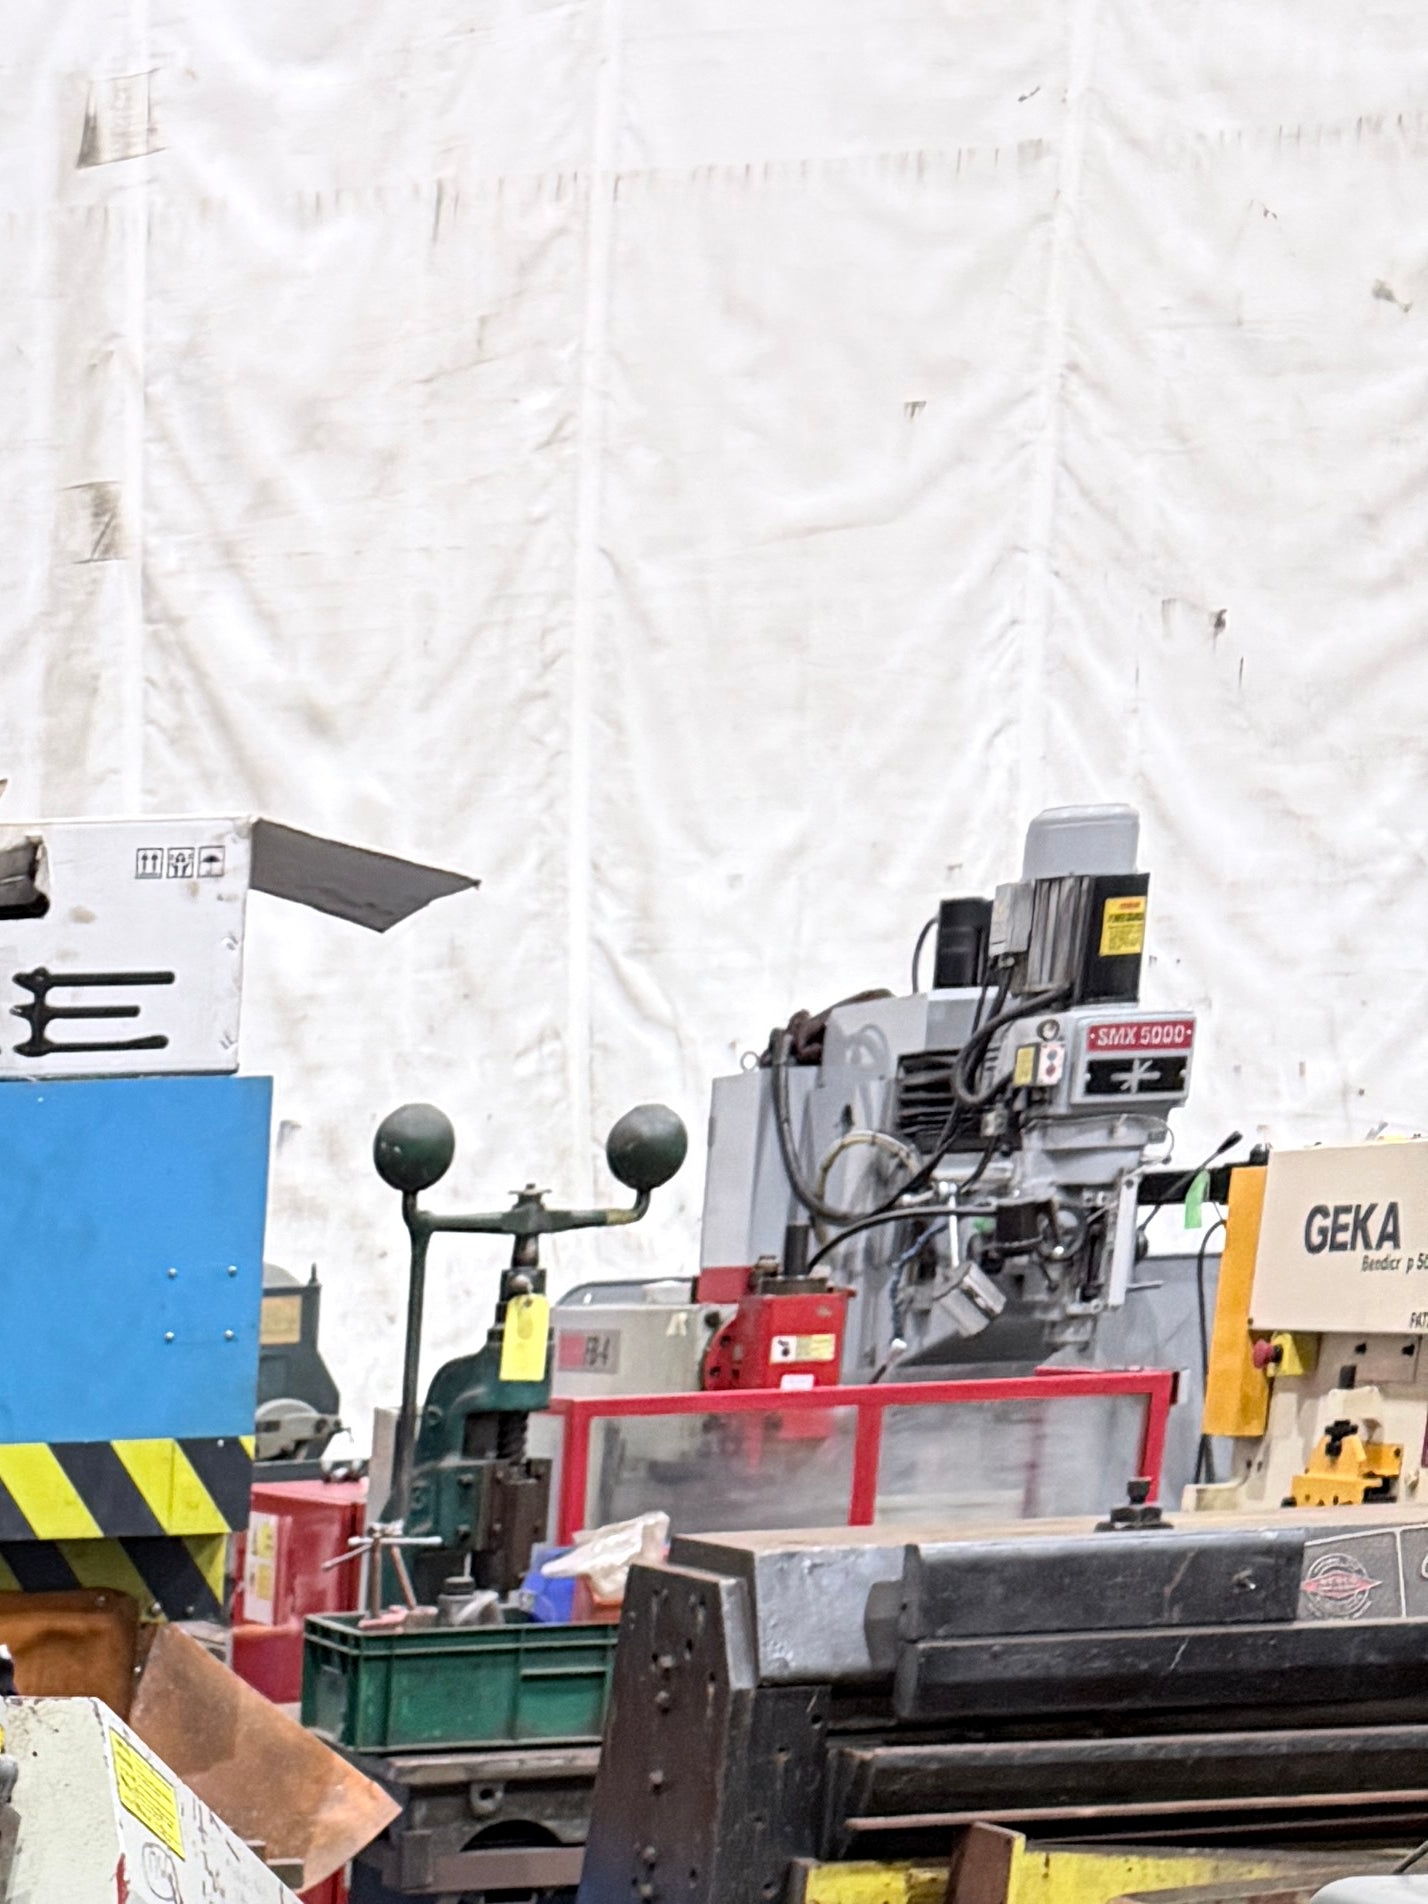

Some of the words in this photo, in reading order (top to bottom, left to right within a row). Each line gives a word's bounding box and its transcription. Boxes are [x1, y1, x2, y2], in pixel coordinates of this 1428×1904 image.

[1097, 1027, 1137, 1046] SMX
[1140, 1025, 1185, 1045] 5000
[1304, 1202, 1401, 1254] GEKA
